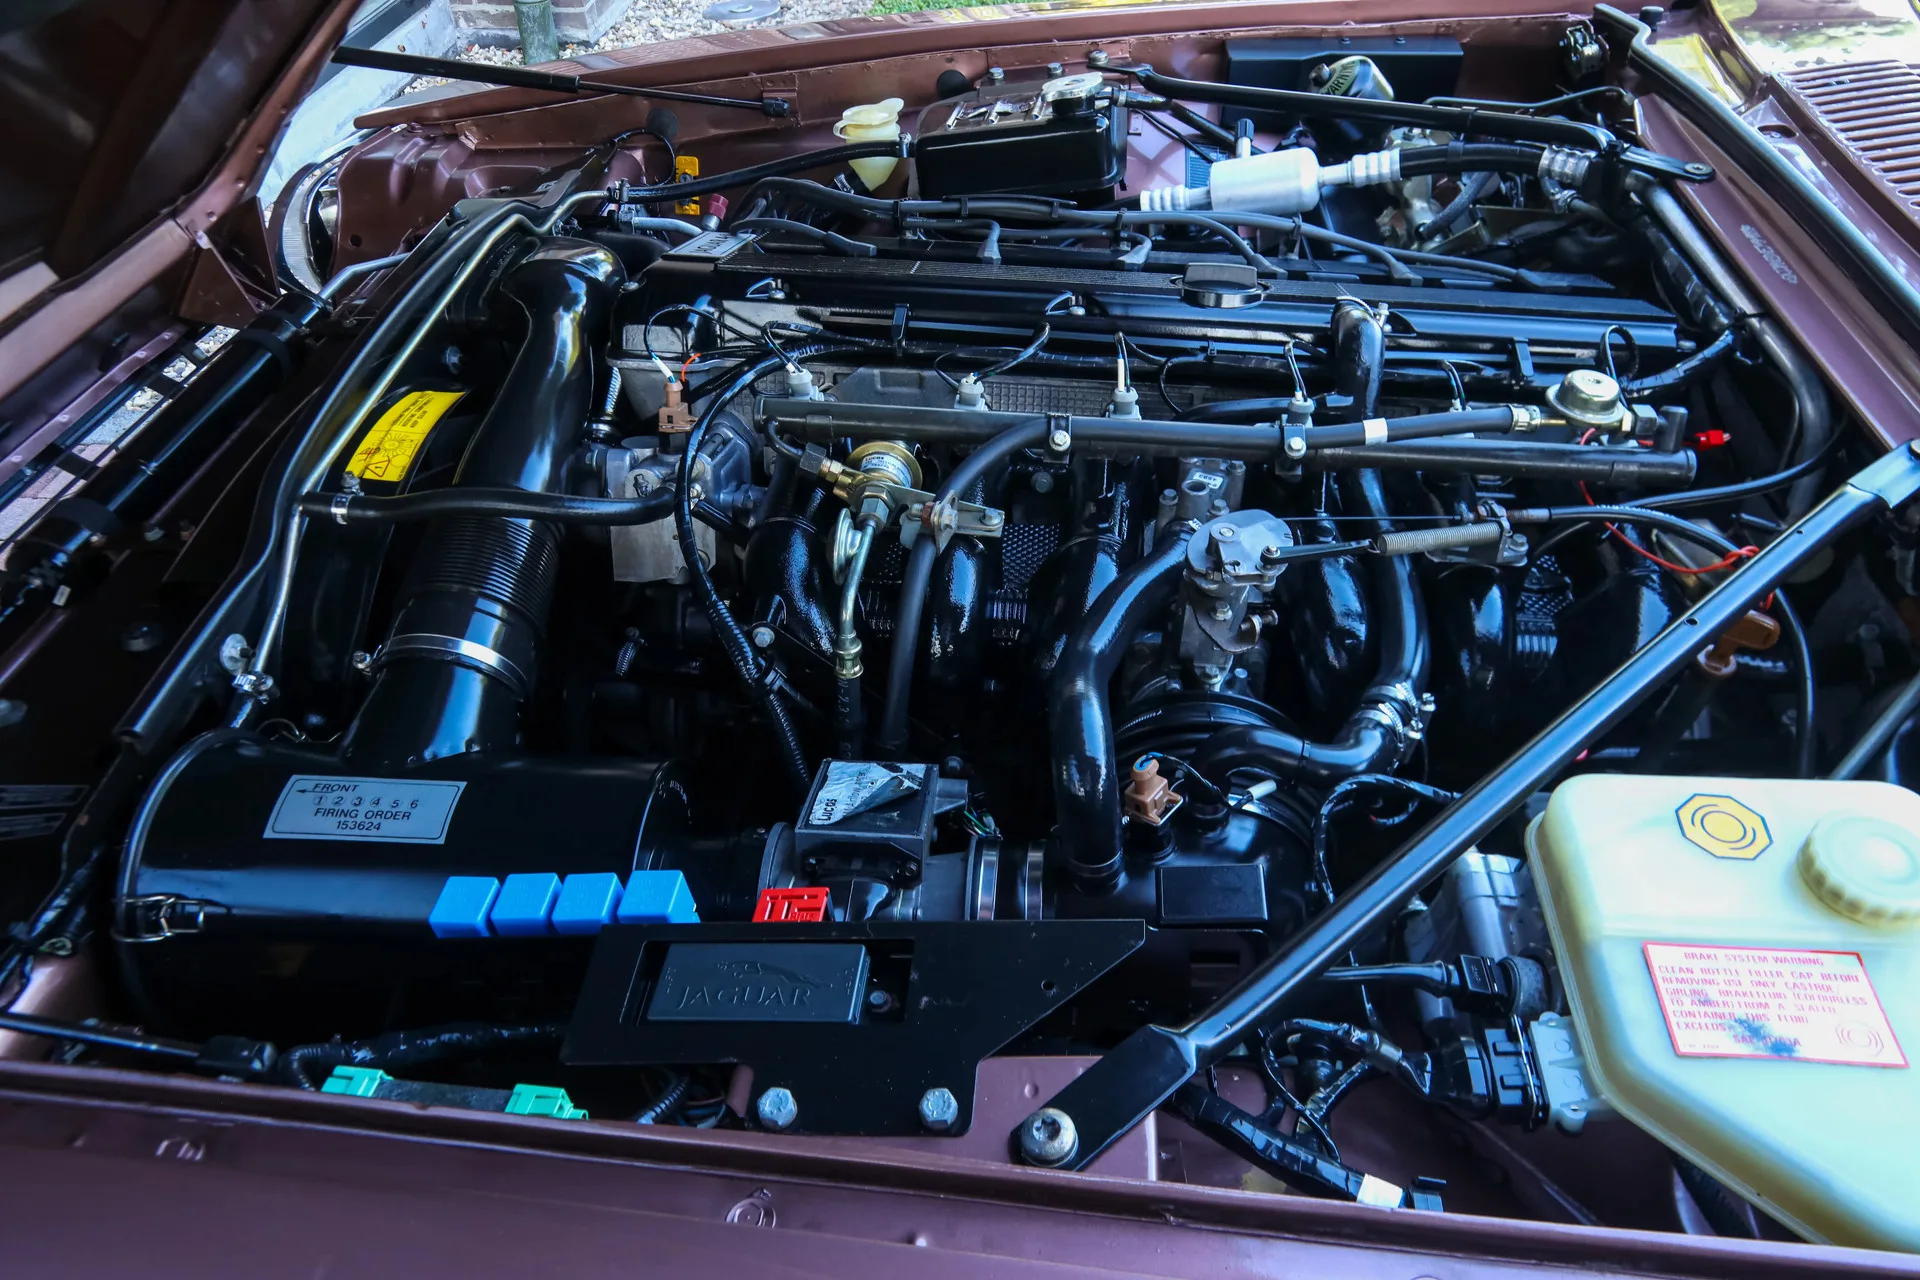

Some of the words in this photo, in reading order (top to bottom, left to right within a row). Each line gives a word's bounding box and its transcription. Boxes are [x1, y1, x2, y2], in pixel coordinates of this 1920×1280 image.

[312, 783, 360, 793] FRONT
[314, 807, 359, 819] FIRING
[364, 810, 412, 821] ORDER
[336, 820, 382, 831] 153624
[1684, 952, 1718, 961] BRAKE
[1724, 954, 1769, 964] SYSTEM
[1771, 956, 1824, 966] WARNING
[1658, 965, 1694, 975] CLEAN
[1700, 967, 1740, 976] BOTTLE
[1748, 969, 1784, 978] FILLER
[1790, 971, 1813, 979] CAP
[1820, 972, 1860, 983] BEFORE
[1661, 976, 1720, 986] REMOVING
[1723, 979, 1742, 987] USE
[1750, 980, 1776, 989] ONLY
[678, 985, 811, 1010] JAGUAR
[1665, 988, 1709, 998] GIRLING
[1670, 998, 1684, 1007] TO
[1737, 1001, 1770, 1010] FROM
[1778, 1003, 1785, 1011] A
[1794, 1004, 1836, 1014] SEALED
[1745, 1012, 1770, 1022] THIS
[1777, 1014, 1809, 1024] FLUID
